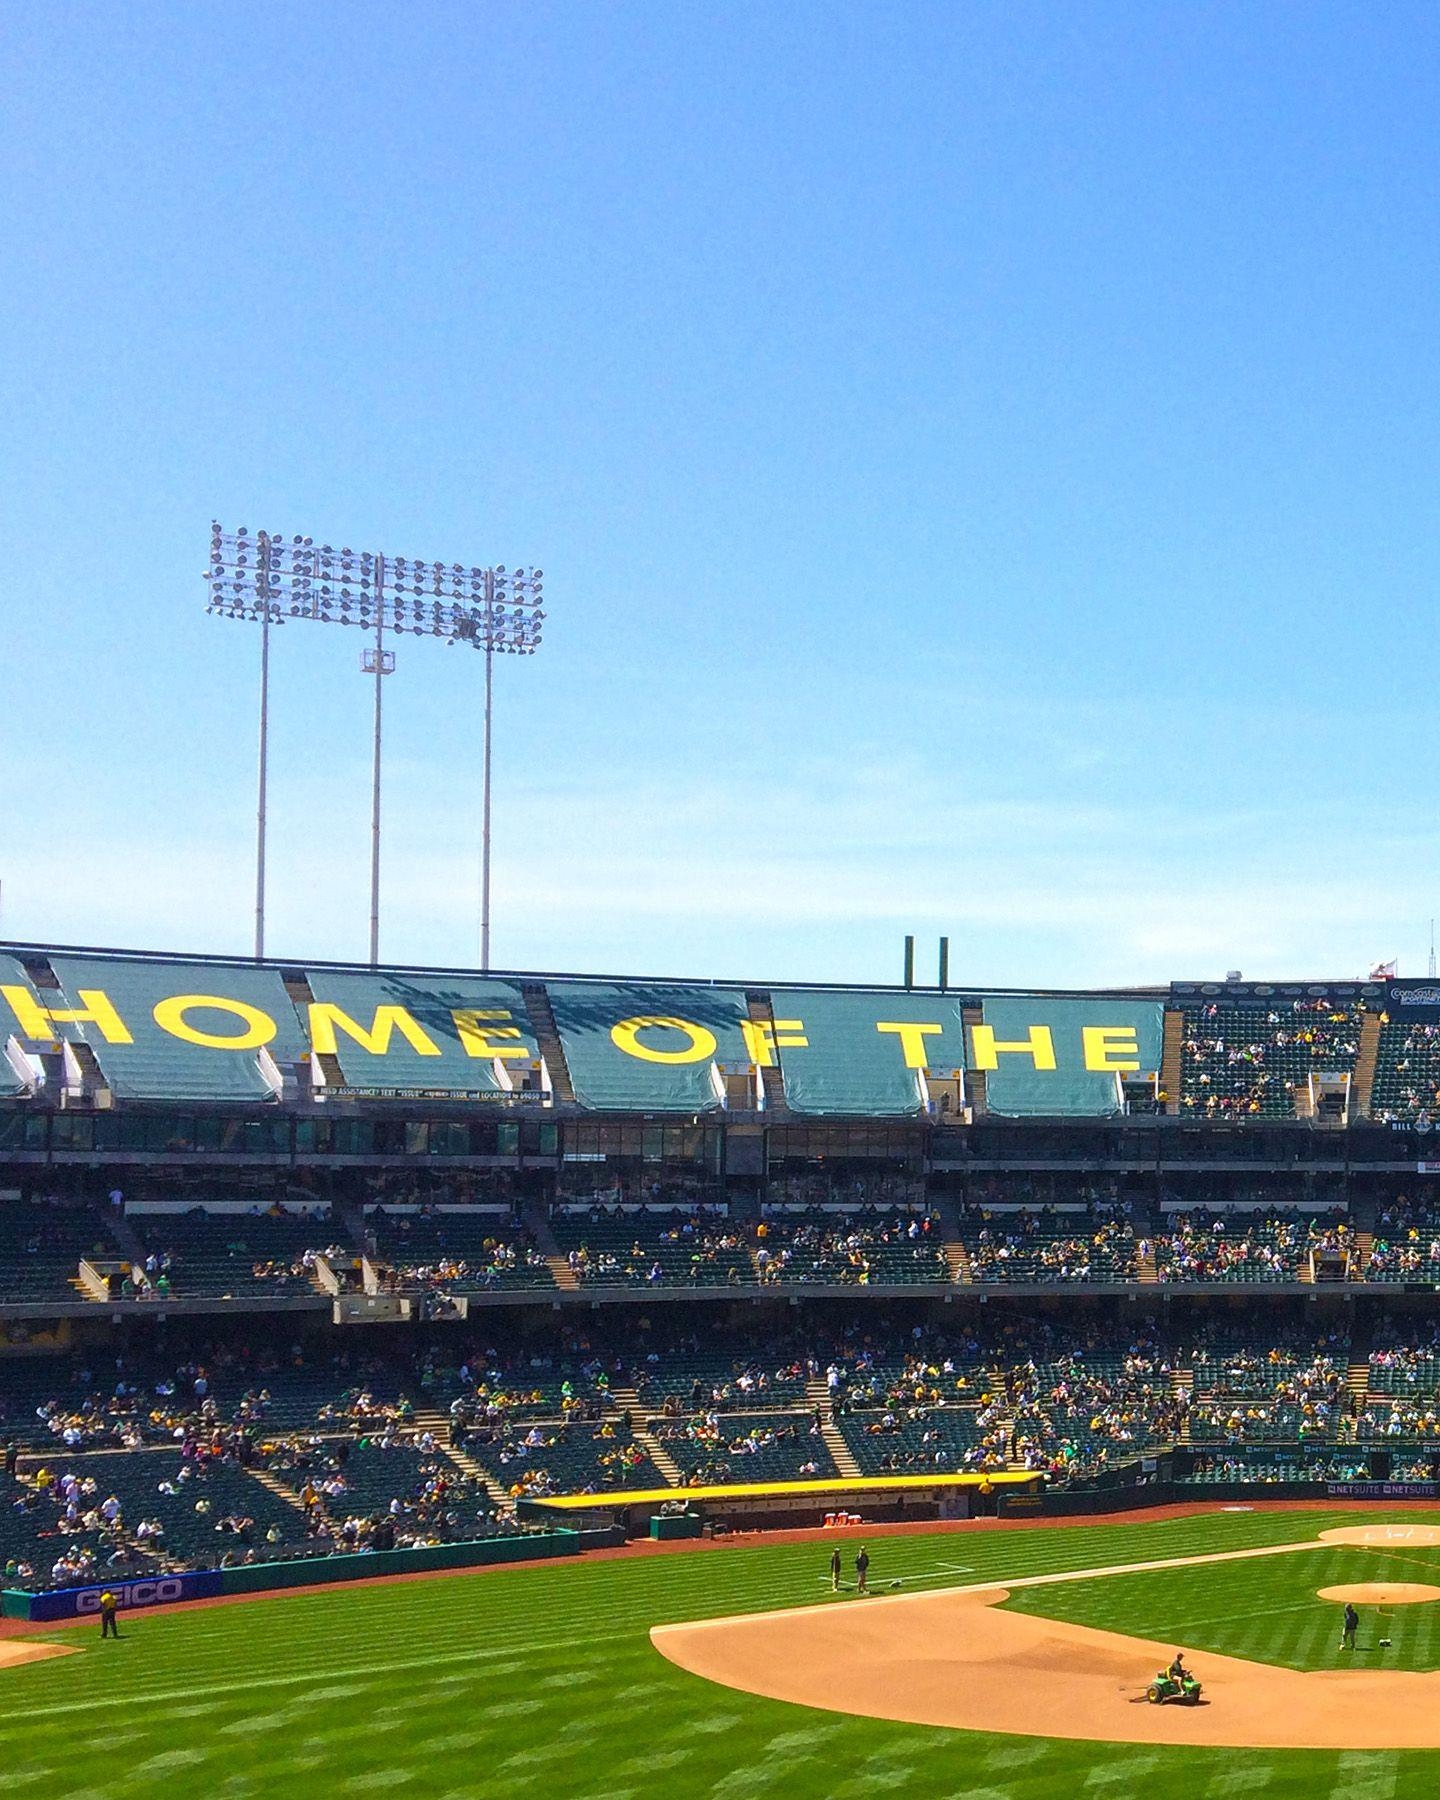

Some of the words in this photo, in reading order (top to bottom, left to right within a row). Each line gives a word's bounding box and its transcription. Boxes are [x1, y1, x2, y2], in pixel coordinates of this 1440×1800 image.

[0, 984, 532, 1059] HOME
[608, 1014, 809, 1067] OF
[876, 1020, 1141, 1072] THE
[381, 1089, 396, 1097] TEXT
[1391, 1122, 1411, 1131] BILL
[1336, 1484, 1380, 1495] NETSUITE
[1392, 1484, 1436, 1495] NETSUITE
